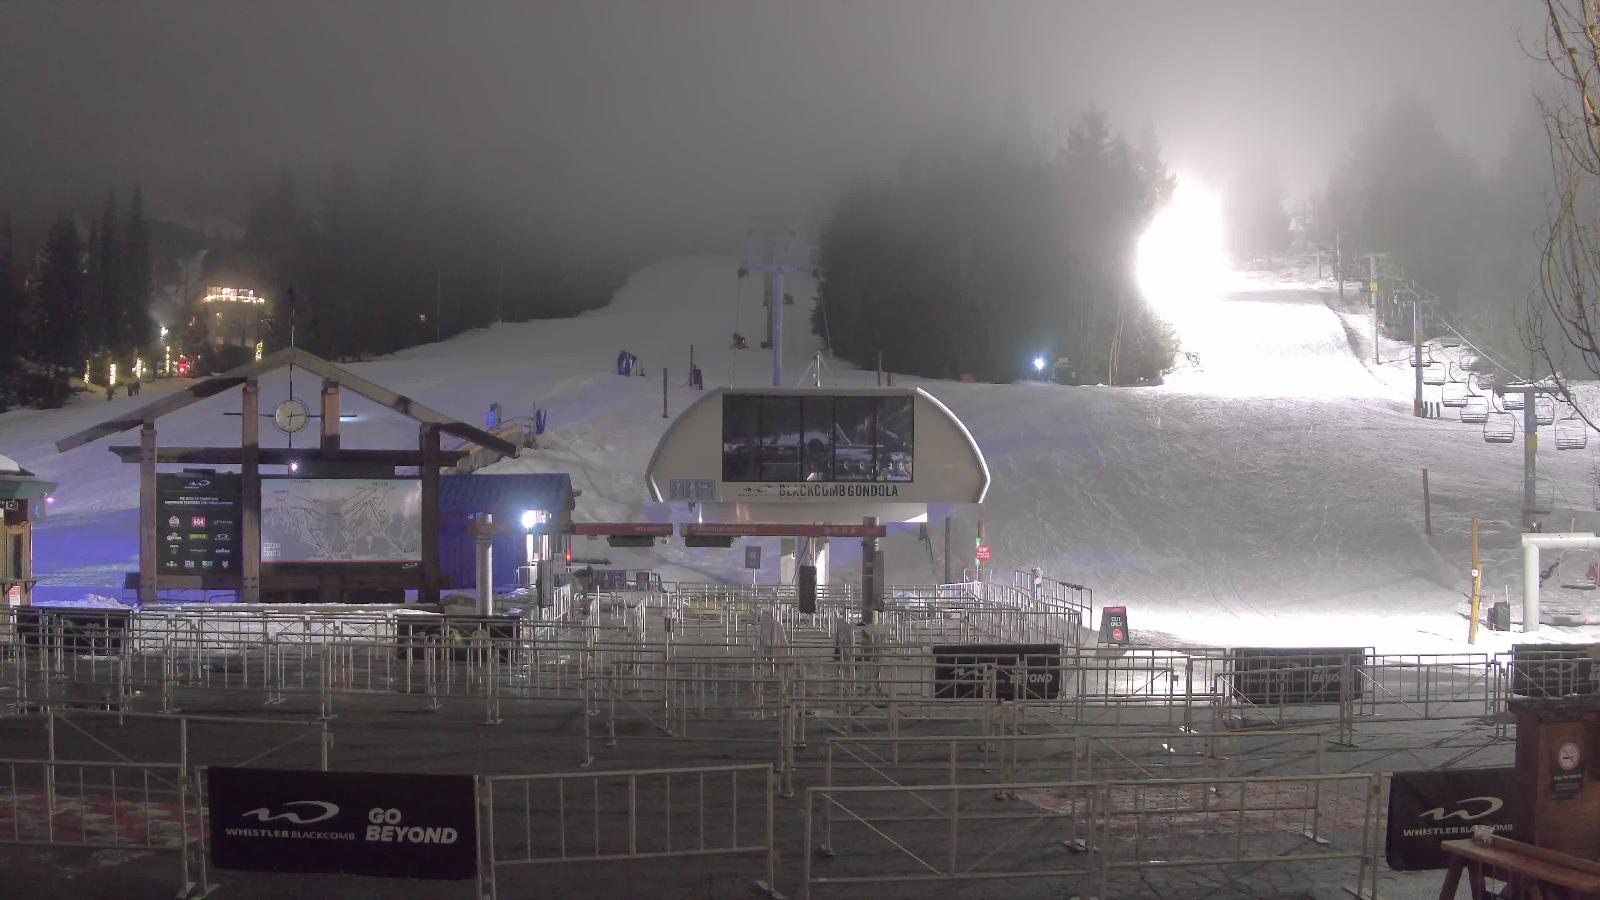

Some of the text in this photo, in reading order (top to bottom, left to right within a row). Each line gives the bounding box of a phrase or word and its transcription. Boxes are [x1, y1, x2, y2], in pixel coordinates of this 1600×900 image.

[779, 484, 899, 497] BLACKCOMB GONDOLA
[368, 808, 402, 824] GO
[225, 827, 357, 840] WHISTLER BLACKCOMB
[365, 825, 458, 844] BEYOND
[1403, 826, 1459, 837] WHISTLER
